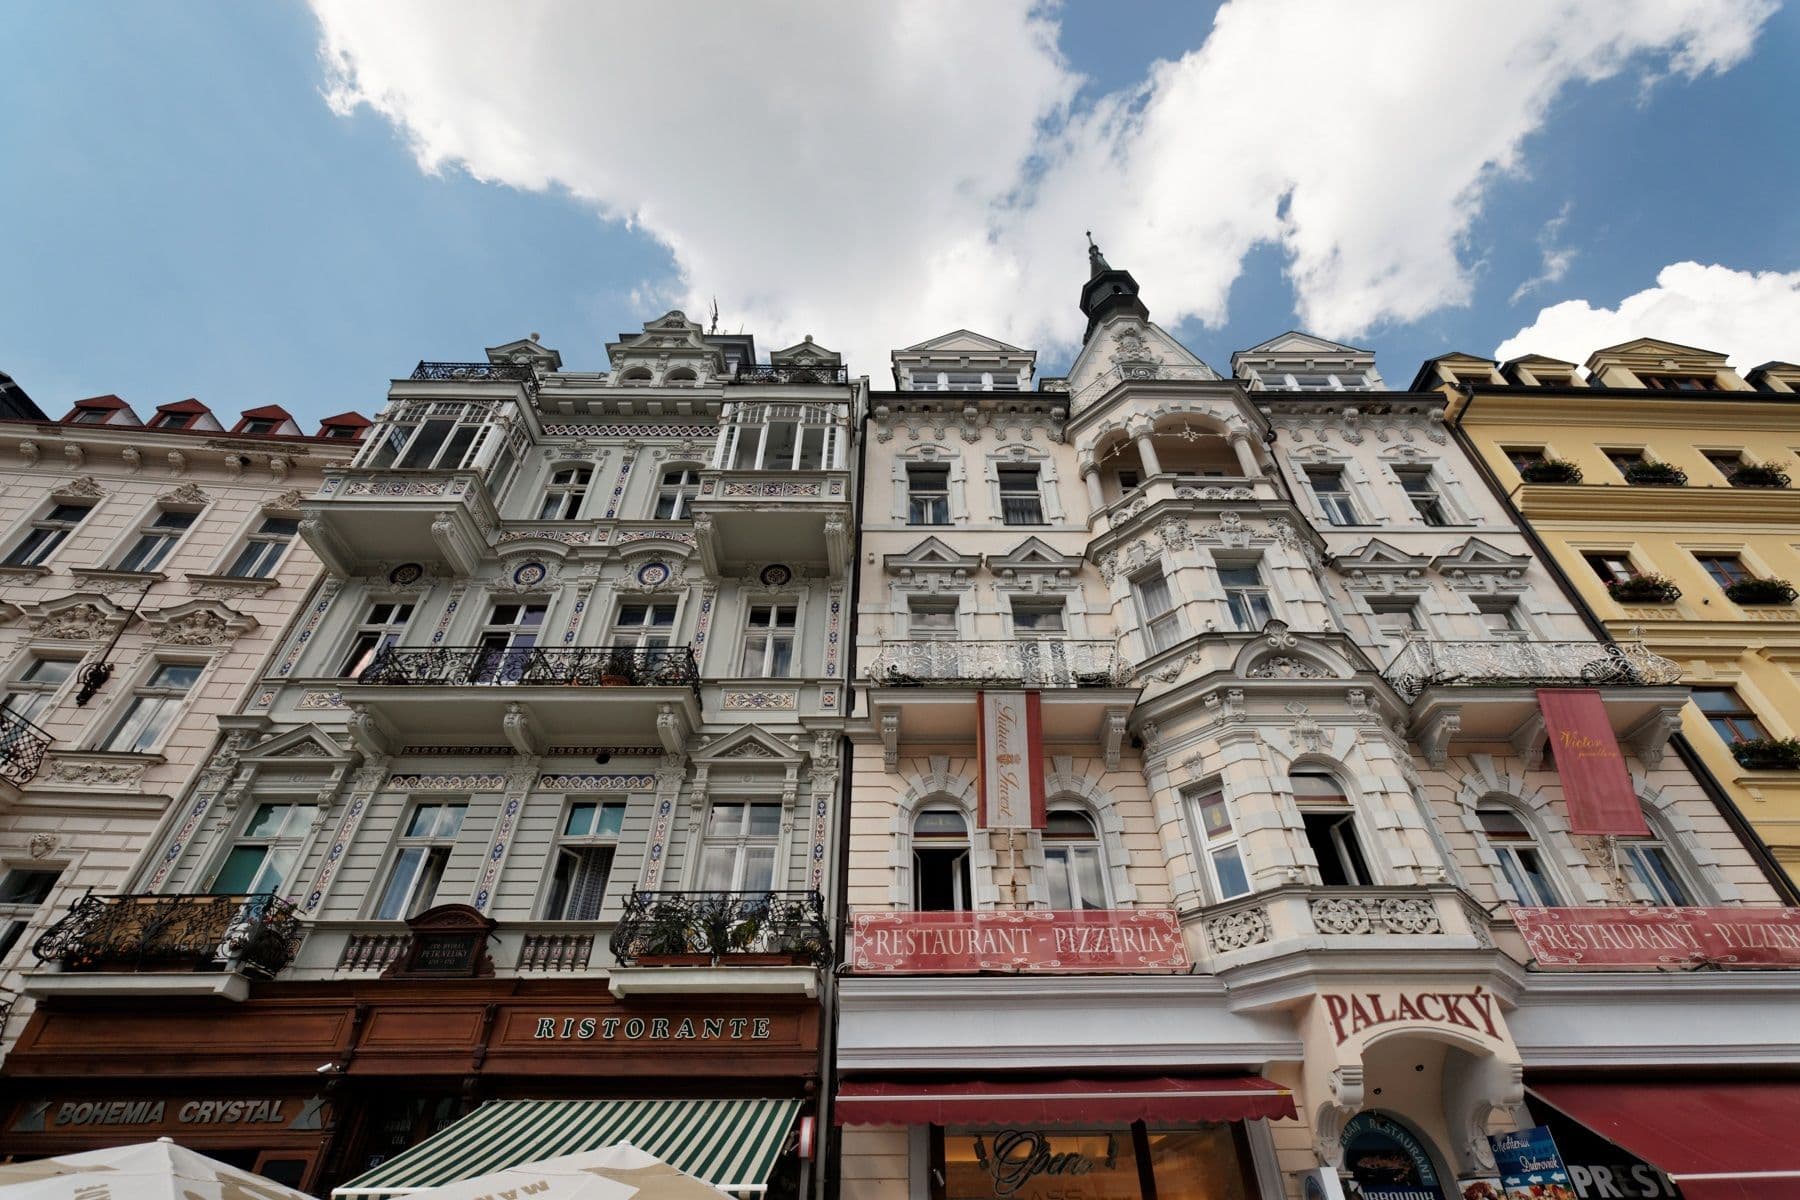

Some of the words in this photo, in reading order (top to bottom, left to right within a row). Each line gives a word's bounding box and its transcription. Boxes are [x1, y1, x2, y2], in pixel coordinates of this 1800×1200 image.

[998, 765, 1020, 818] Invest
[874, 927, 1032, 955] RESTAURANT
[1052, 926, 1166, 953] PIZZERIA
[1540, 923, 1703, 949] RESTAURANT
[534, 1017, 770, 1039] RISTORANTE
[1322, 985, 1504, 1047] PALACKÝ
[54, 1101, 165, 1126] BOHEMIA
[178, 1100, 285, 1124] CRYSTAL
